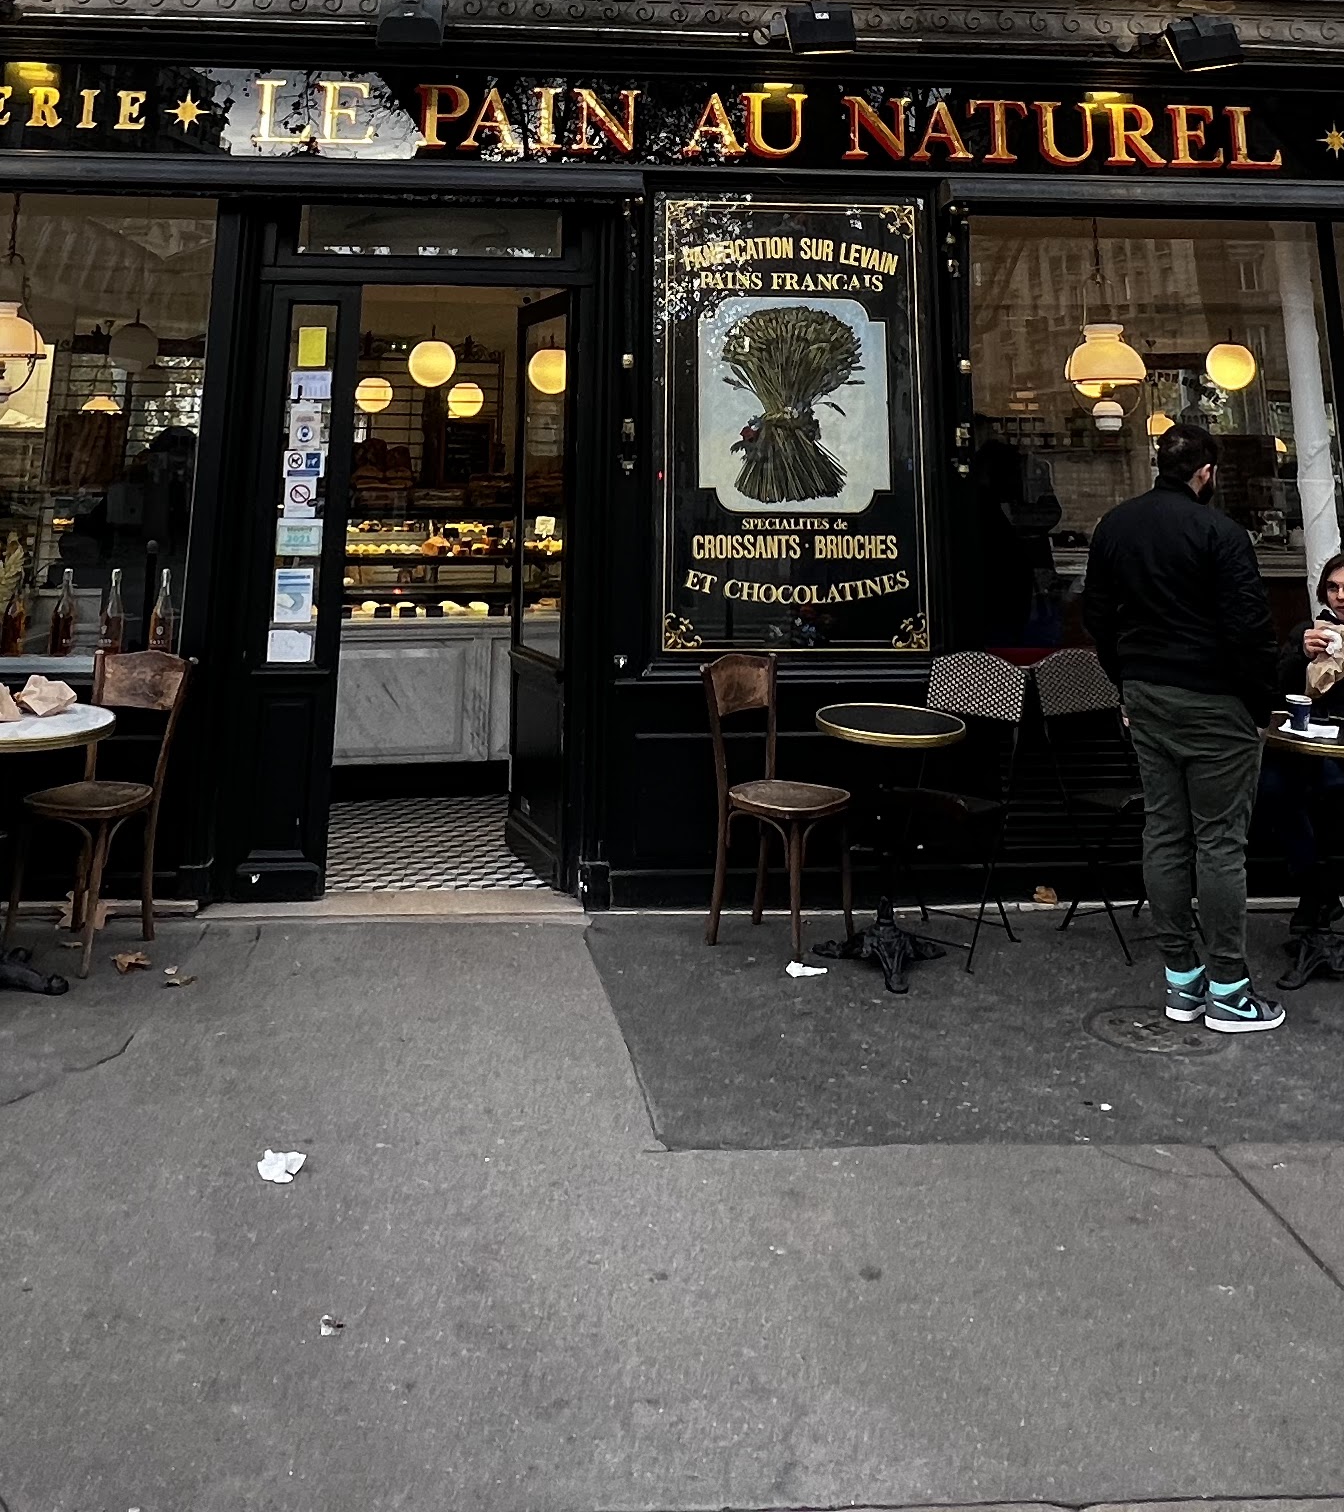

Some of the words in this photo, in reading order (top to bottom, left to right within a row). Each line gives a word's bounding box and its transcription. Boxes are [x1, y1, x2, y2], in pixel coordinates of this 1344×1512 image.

[253, 78, 374, 145] LE
[414, 83, 642, 155] PAIN
[682, 90, 809, 160] AU
[840, 95, 1283, 171] NATUREL
[799, 237, 834, 262] SUR
[839, 242, 899, 276] LEVAIN
[698, 271, 762, 290] PAINS
[833, 517, 848, 530] de
[692, 534, 801, 559] CROISSANTS
[814, 534, 898, 559] BRIOCHES
[685, 569, 718, 594] ET
[723, 570, 910, 604] CHOCOLATINES
